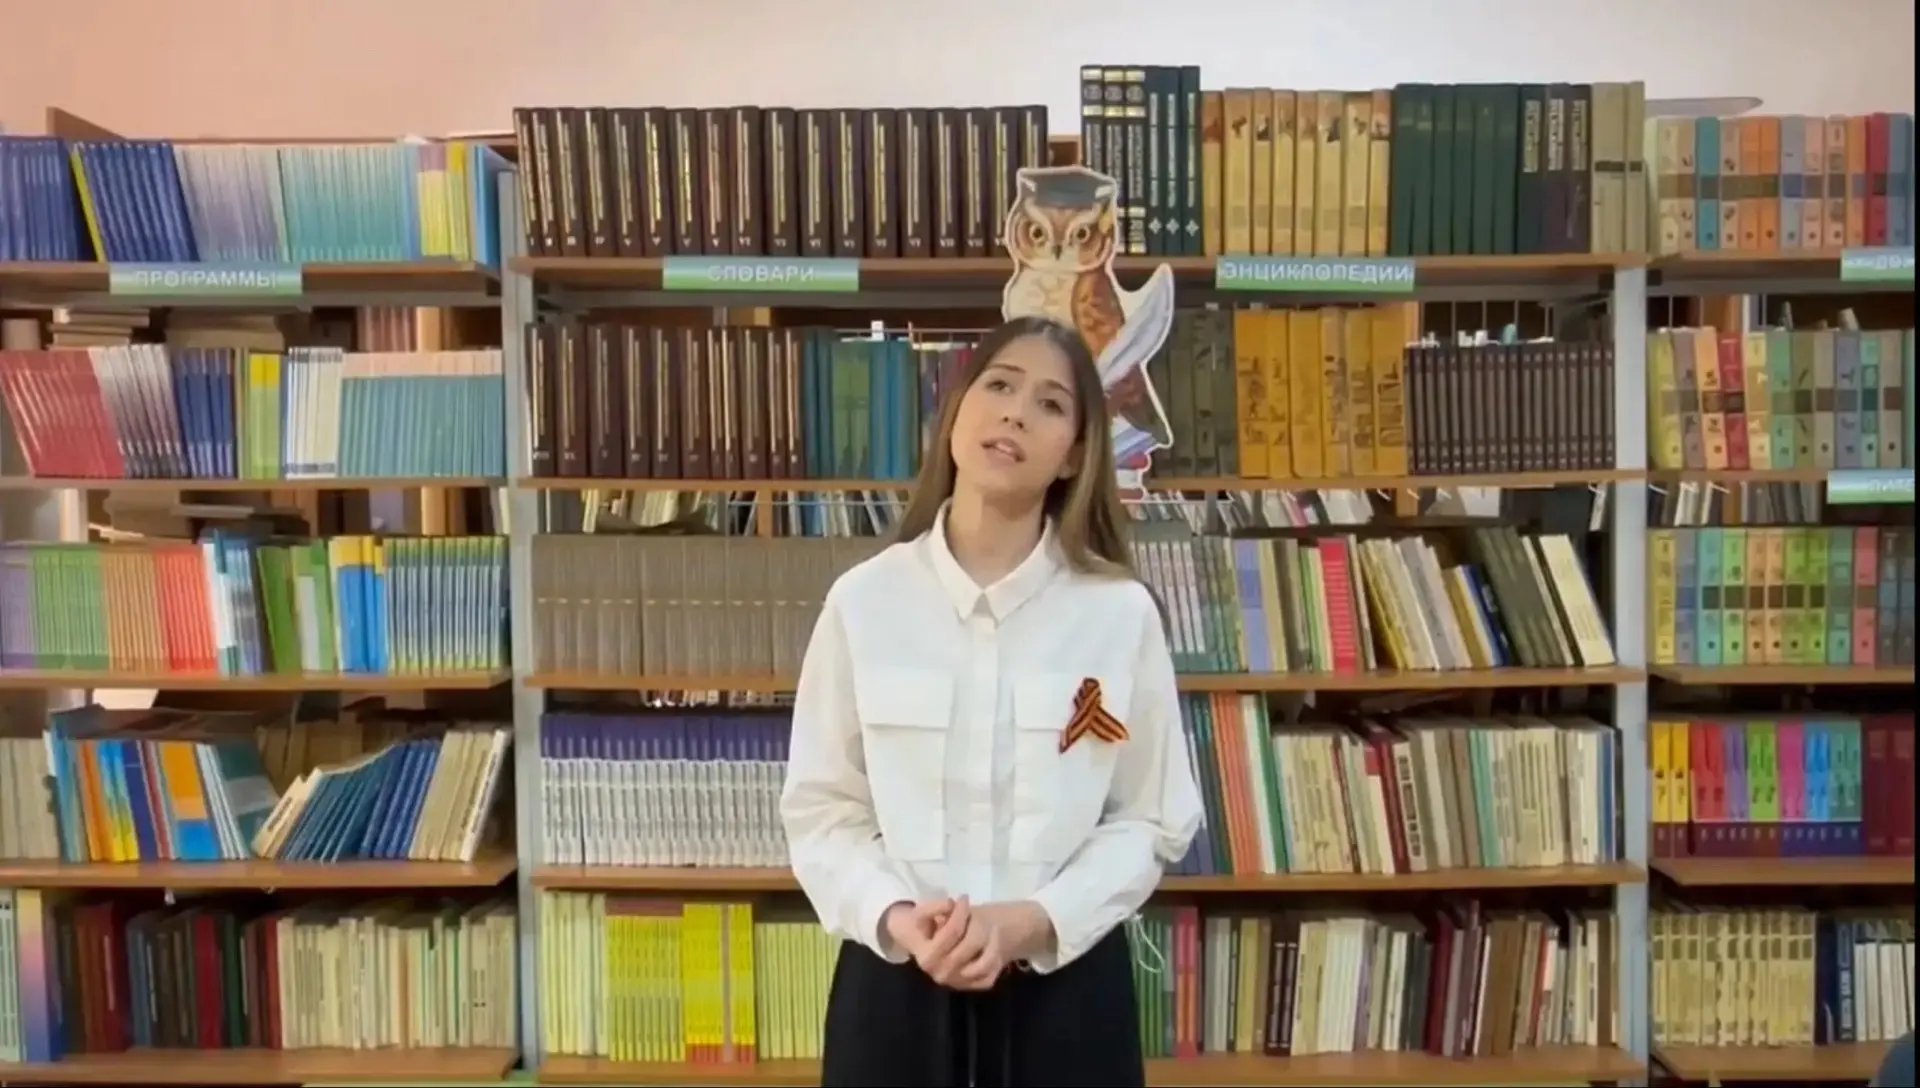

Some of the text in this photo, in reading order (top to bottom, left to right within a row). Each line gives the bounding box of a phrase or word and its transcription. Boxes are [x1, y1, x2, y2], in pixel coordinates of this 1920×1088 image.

[135, 269, 277, 288] ПРОГРАММЫ
[707, 264, 815, 283] СЛОВАРИ
[1223, 261, 1410, 284] ЭНЦИКЛОПЕДИИ
